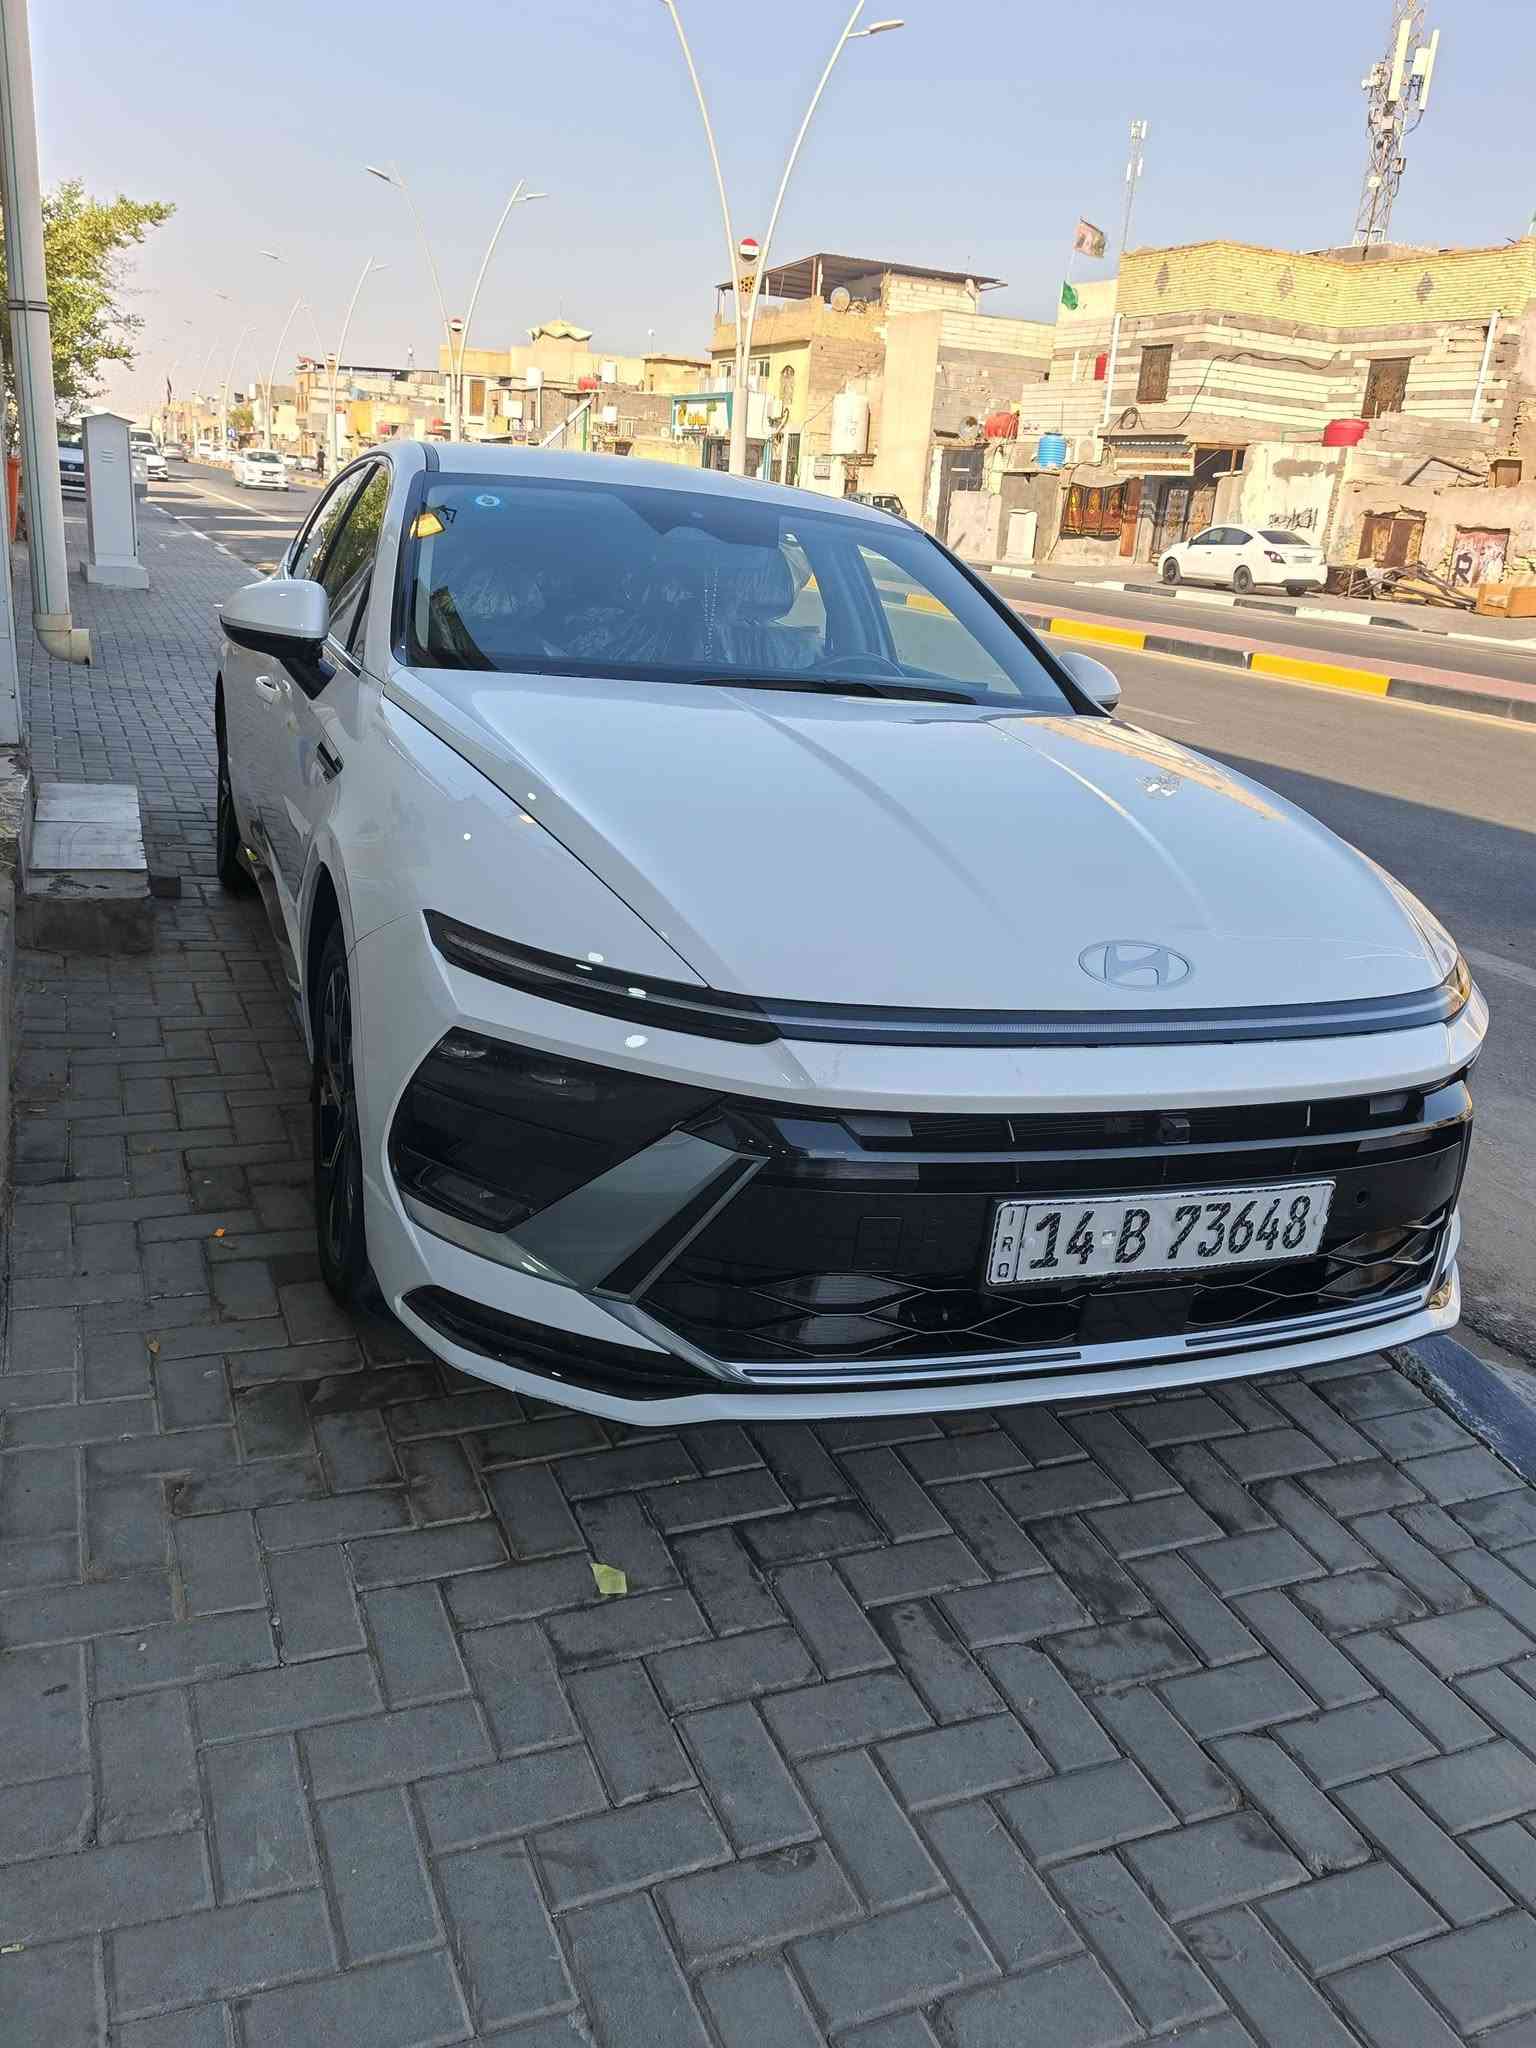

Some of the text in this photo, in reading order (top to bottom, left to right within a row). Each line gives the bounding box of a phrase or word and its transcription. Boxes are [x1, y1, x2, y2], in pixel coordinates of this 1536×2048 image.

[1030, 1195, 1312, 1269] 14 B 73648
